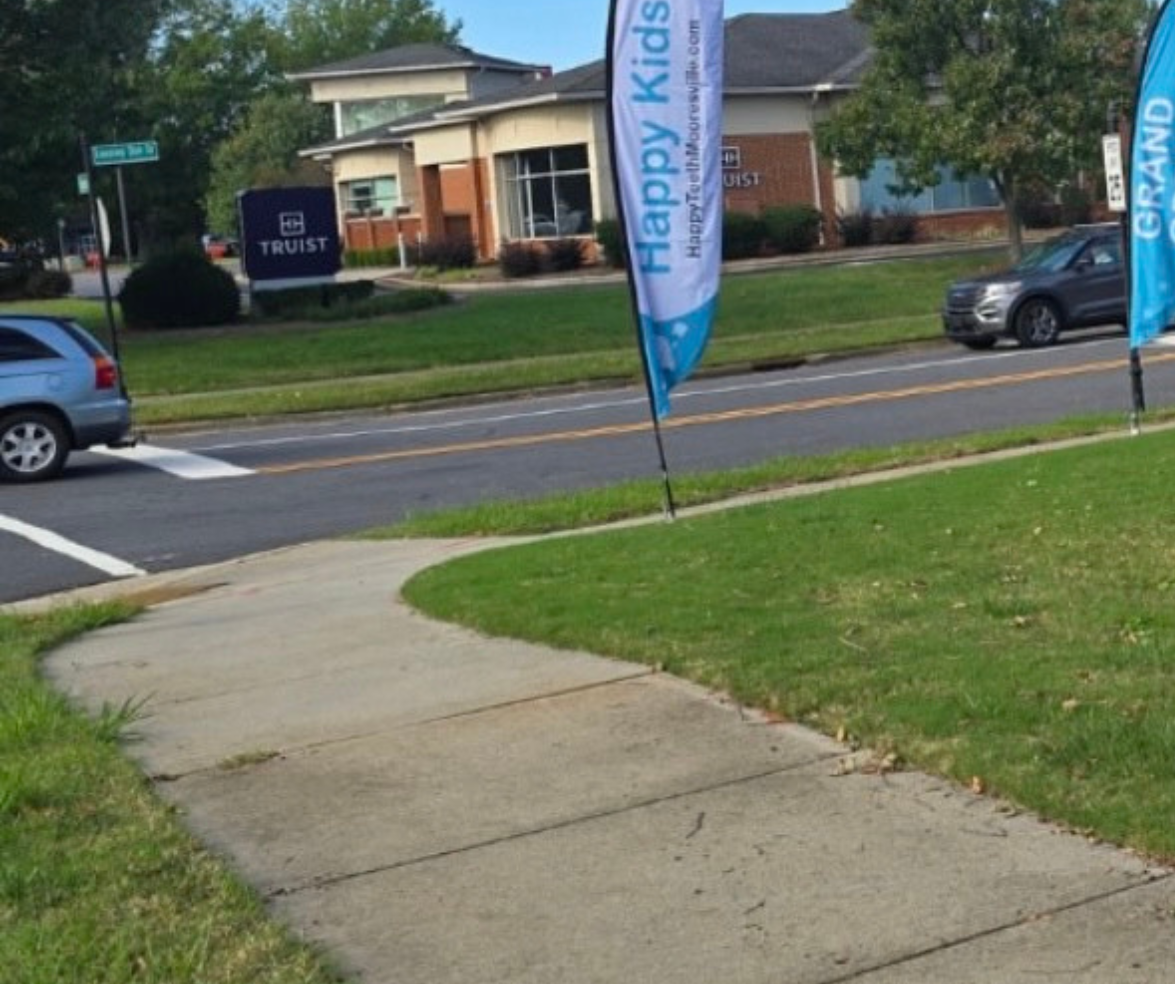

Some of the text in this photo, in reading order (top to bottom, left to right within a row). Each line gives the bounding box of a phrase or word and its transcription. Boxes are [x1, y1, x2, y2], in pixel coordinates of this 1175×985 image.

[631, 0, 681, 274] Happy Kids
[1134, 97, 1175, 239] GRAND
[722, 171, 765, 188] UIST
[257, 236, 329, 256] TRUIST
